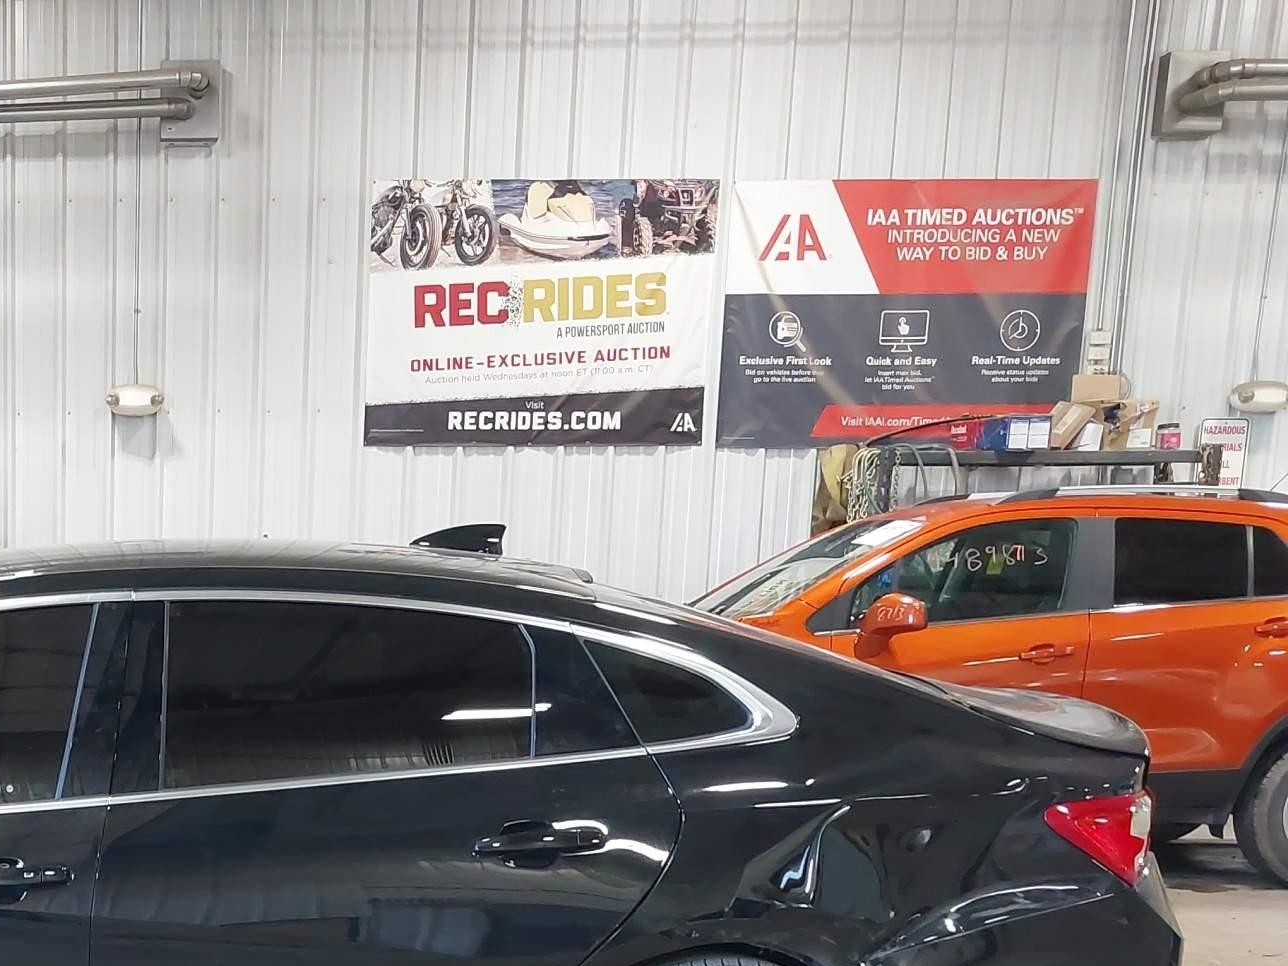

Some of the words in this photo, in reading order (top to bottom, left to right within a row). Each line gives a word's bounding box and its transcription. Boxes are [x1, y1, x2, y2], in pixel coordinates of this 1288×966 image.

[866, 208, 900, 226] IAA
[904, 208, 967, 226] TIMED
[887, 228, 1001, 244] INTRODUCING
[1003, 229, 1017, 243] A
[1021, 228, 1061, 243] NEW
[896, 246, 934, 261] WAY
[938, 246, 961, 261] TO
[965, 246, 992, 261] BID
[995, 246, 1008, 261] &
[1013, 246, 1049, 261] BUY
[414, 281, 509, 329] REC
[523, 271, 668, 323] RIDES
[556, 327, 563, 339] A
[565, 323, 626, 338] POWERSPORT
[627, 321, 665, 335] AUCTION
[410, 350, 587, 373] ONLINE-EXCLUSIVE
[594, 346, 671, 364] AUCTION
[739, 355, 784, 366] Exclusive
[785, 355, 807, 366] First
[809, 356, 832, 366] Look
[865, 356, 892, 366] Quick
[893, 356, 912, 366] and
[914, 356, 937, 367] Easy
[971, 355, 1020, 365] Real-Time
[1022, 355, 1061, 367] Updates
[425, 375, 460, 385] Auction
[461, 374, 480, 383] held
[482, 372, 538, 383] Wednesdays
[538, 371, 549, 379] at
[525, 401, 545, 410] Visit
[447, 410, 622, 431] RECRIDES.COM
[840, 415, 863, 427] Visit
[1203, 425, 1246, 435] HAZARDOUS
[1223, 442, 1243, 452] RIALS
